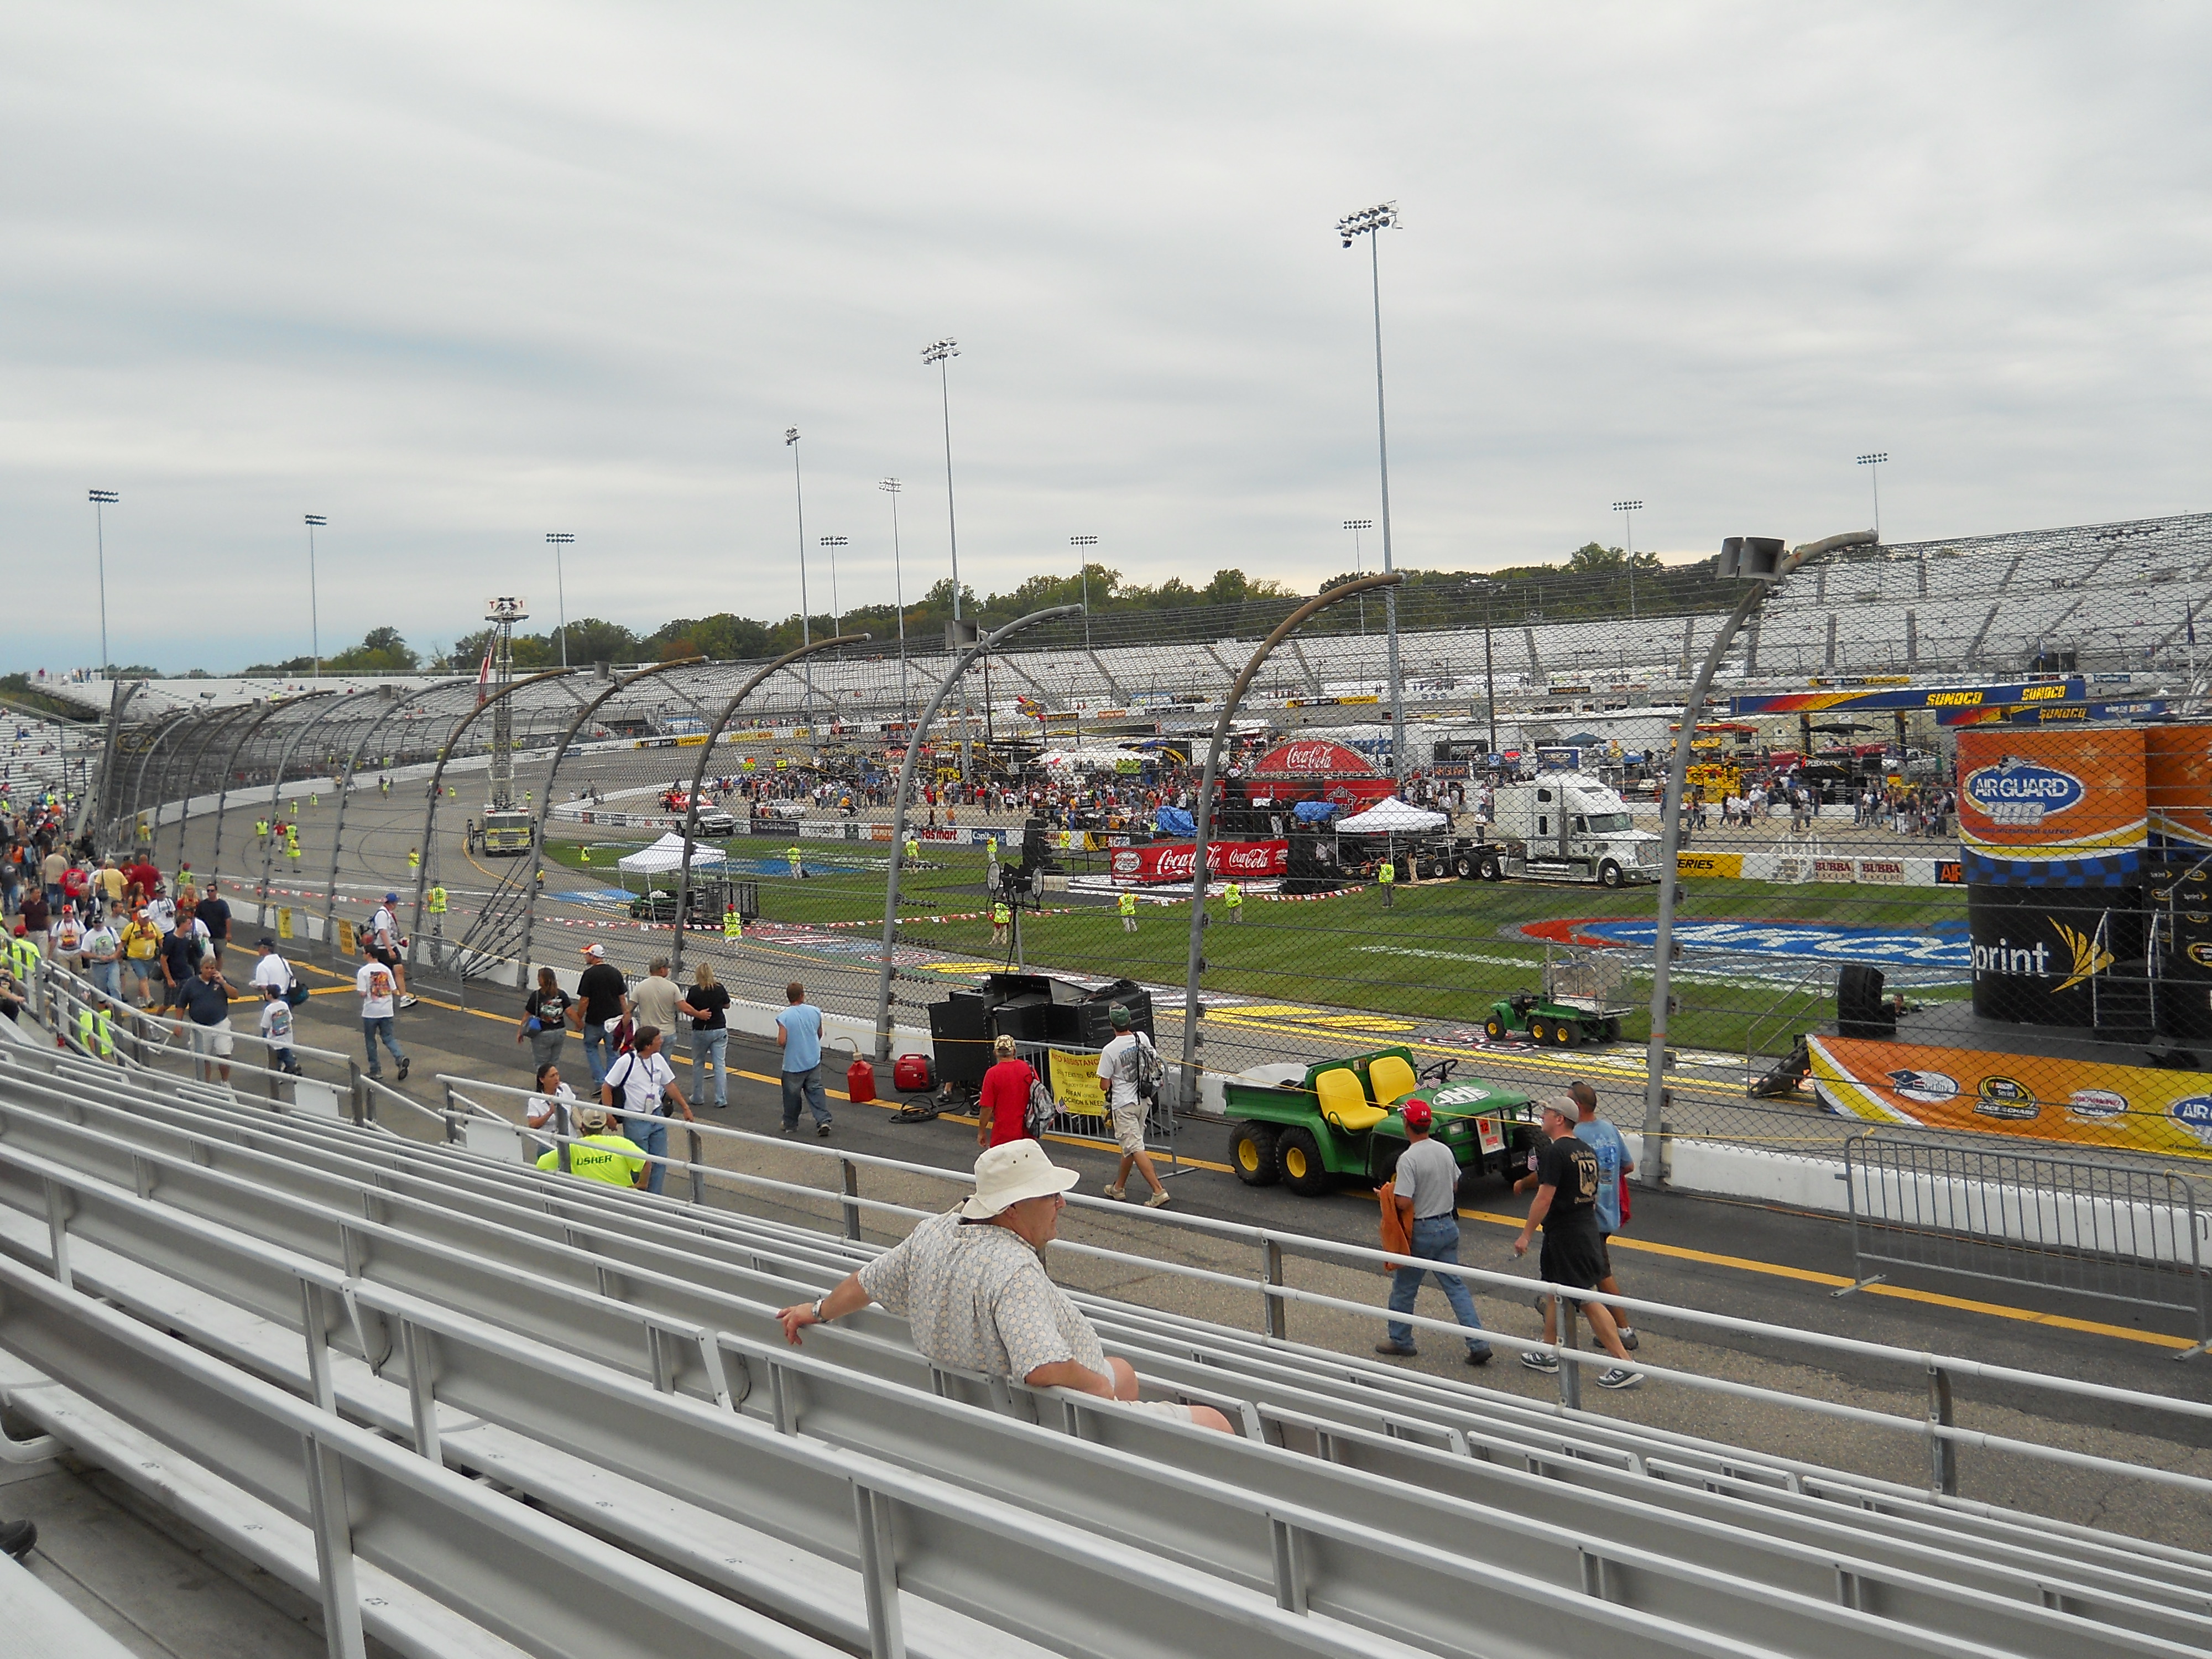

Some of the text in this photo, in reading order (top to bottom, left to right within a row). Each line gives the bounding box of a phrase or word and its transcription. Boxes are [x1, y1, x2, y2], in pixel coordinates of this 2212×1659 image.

[489, 601, 495, 609] T
[2021, 685, 2066, 701] SUNOCO
[1926, 692, 1983, 706] SUNOCO
[1017, 705, 1045, 713] SUNOCO
[2038, 707, 2087, 719] SUNOCO
[1286, 744, 1334, 769] Coca-Cola
[1975, 778, 2069, 797] AIR GUARD
[972, 831, 993, 842] Capit
[1156, 845, 1223, 875] Coca-Cla
[1229, 847, 1270, 869] Coca-Cola
[1676, 859, 1714, 869] ERIES
[1814, 861, 1850, 872] BUBBA
[1861, 863, 1900, 873] BUBBA
[1063, 1056, 1100, 1067] ASSISTANC
[1438, 1086, 1486, 1104] JHE
[1997, 1089, 2016, 1098] Sprint
[2075, 1095, 2121, 1106] RICHMOND
[2007, 1108, 2036, 1116] CHASE
[2183, 1103, 2209, 1120] AIR
[1480, 1123, 1489, 1132] 12
[576, 1154, 612, 1166] USHER
